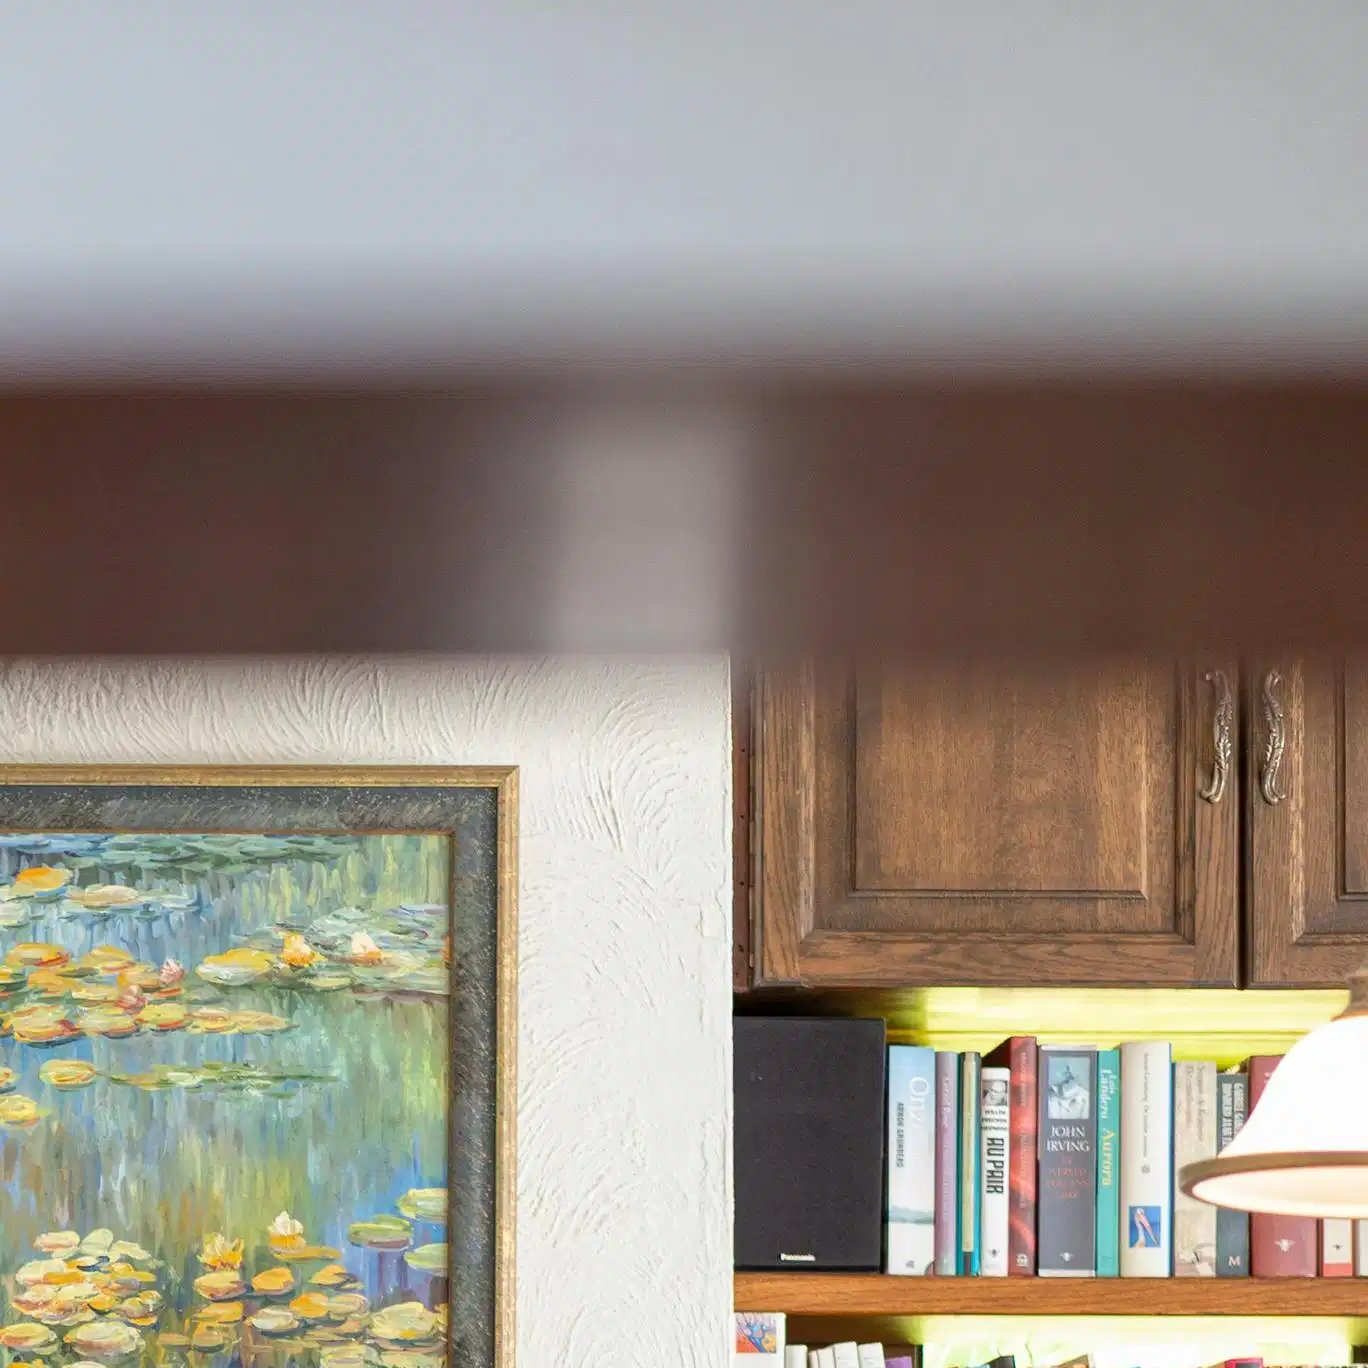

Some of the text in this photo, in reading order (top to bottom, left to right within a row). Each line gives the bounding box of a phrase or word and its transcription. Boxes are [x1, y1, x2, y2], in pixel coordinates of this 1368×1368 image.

[1051, 1126, 1085, 1138] JOHN
[986, 1137, 1004, 1157] AU
[1046, 1140, 1091, 1153] IRVING
[1102, 1129, 1117, 1188] Aurora
[986, 1160, 1004, 1194] PAIR
